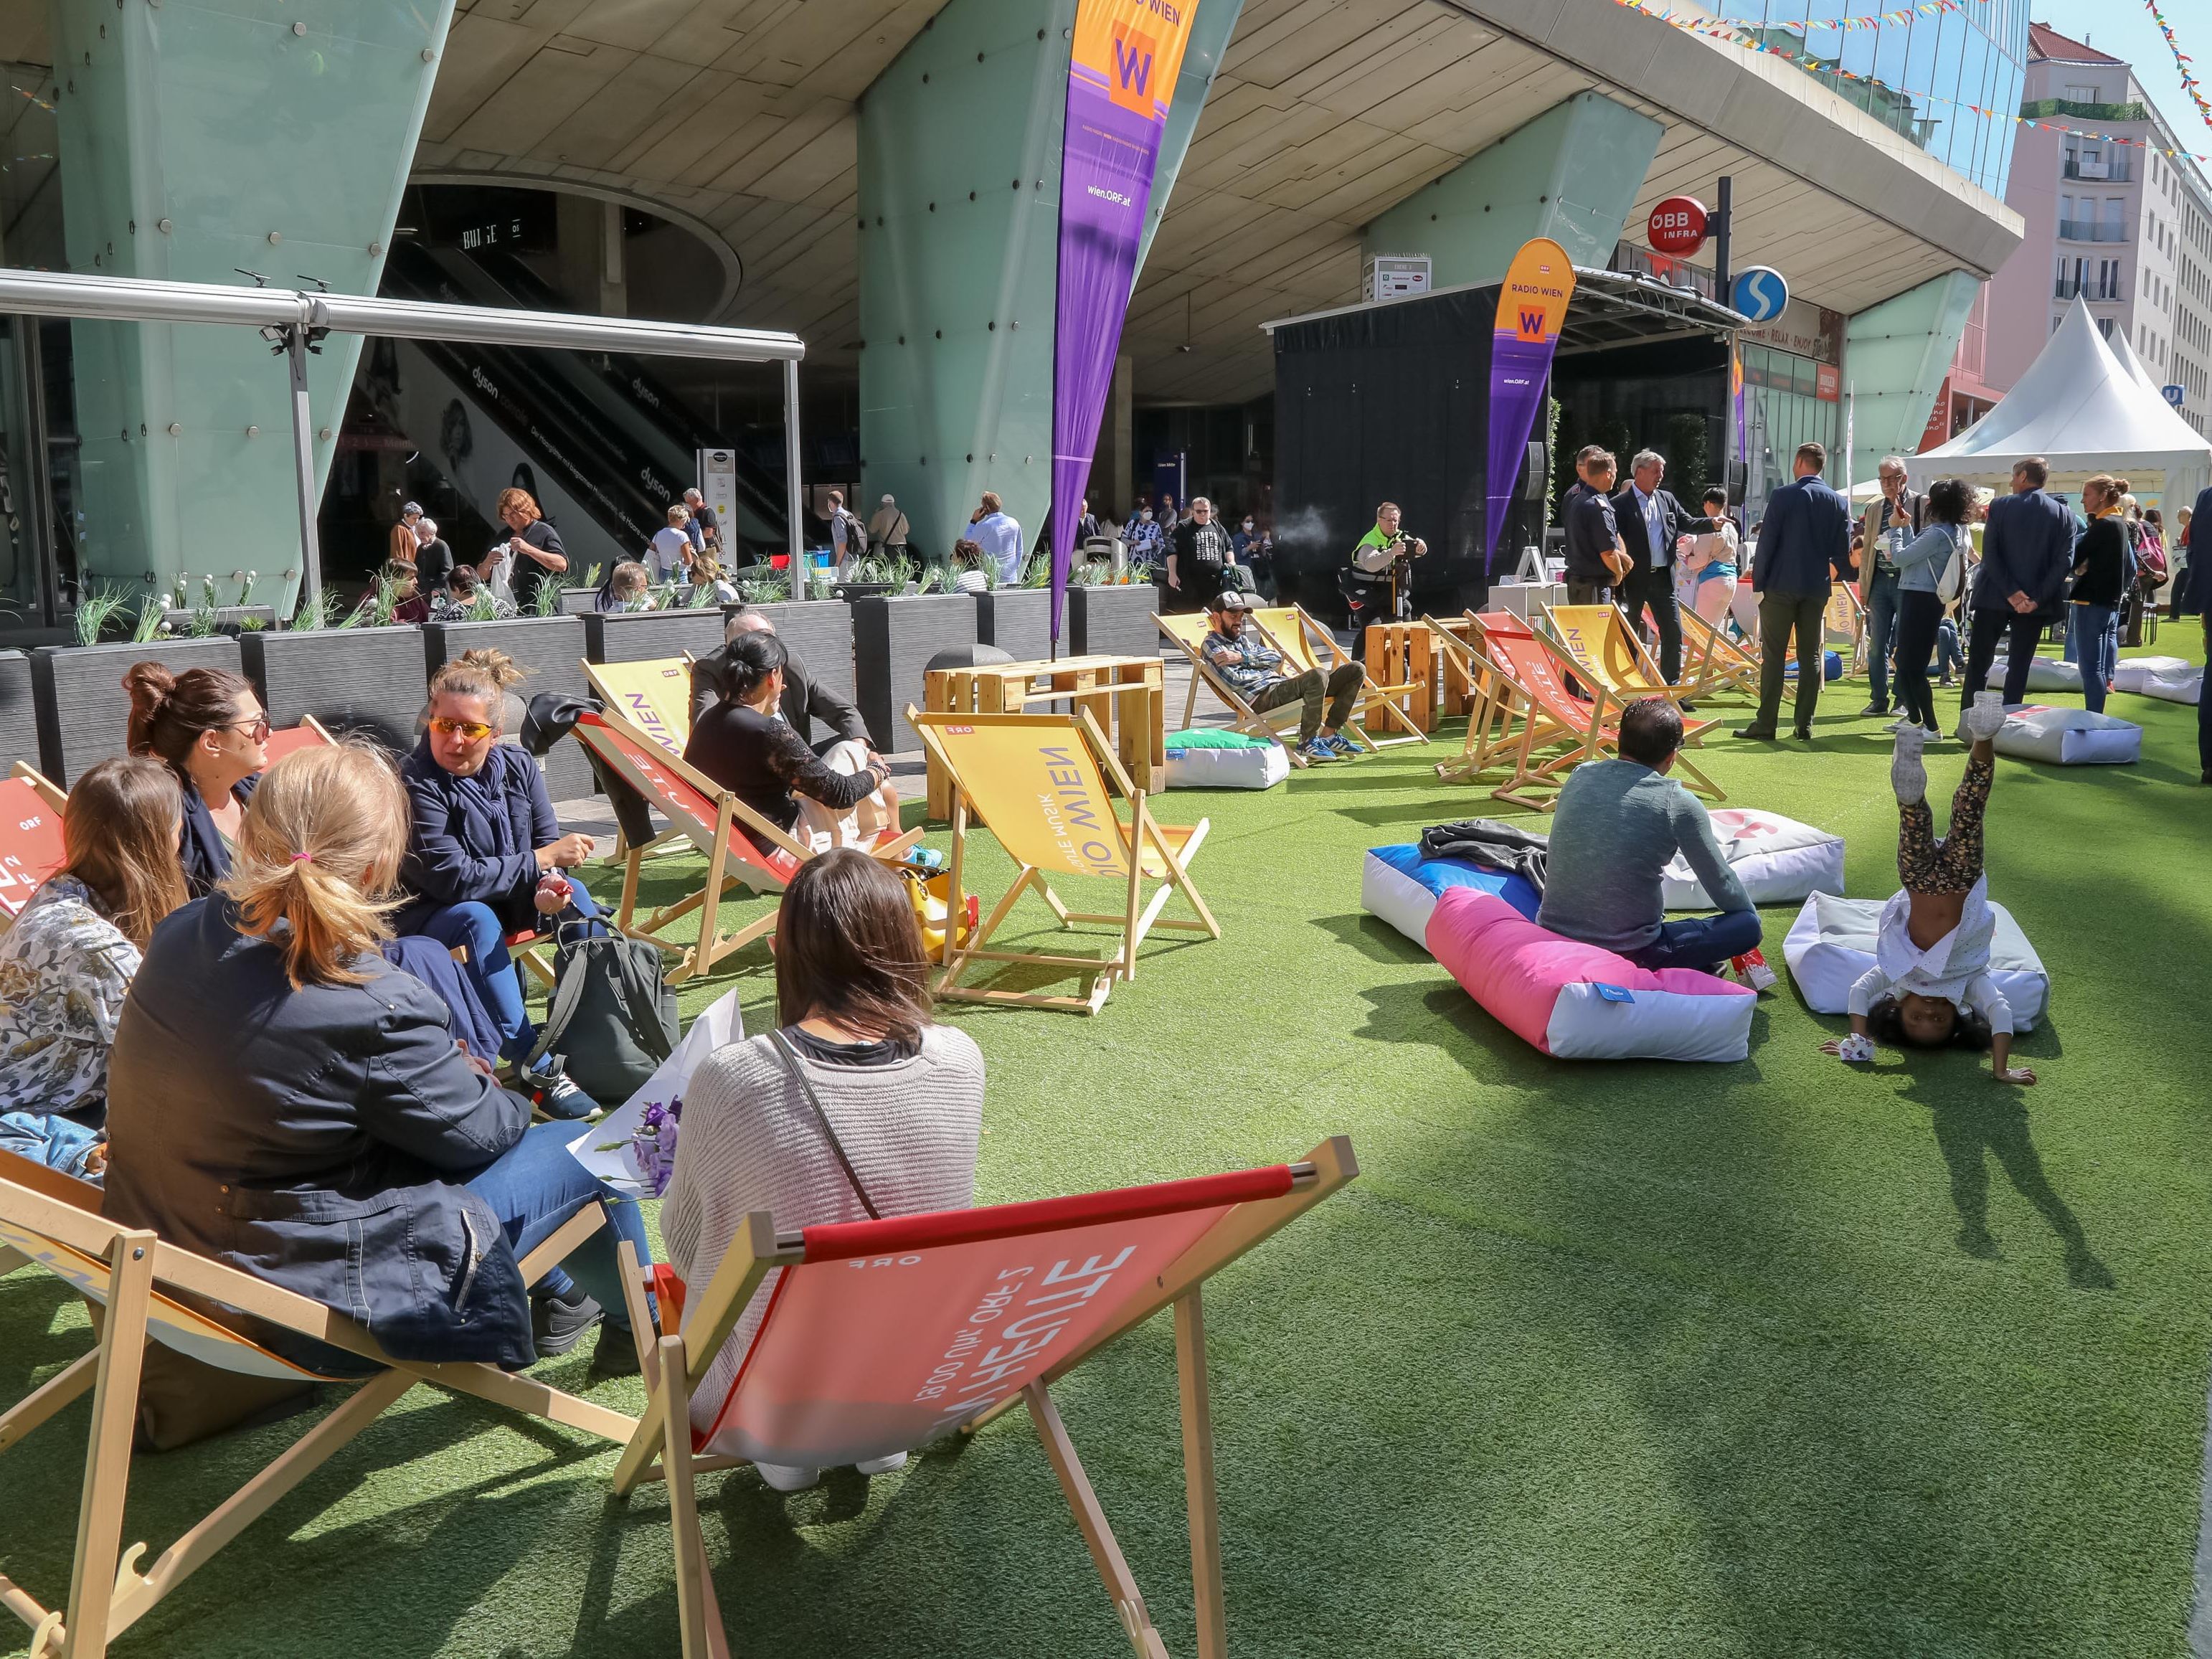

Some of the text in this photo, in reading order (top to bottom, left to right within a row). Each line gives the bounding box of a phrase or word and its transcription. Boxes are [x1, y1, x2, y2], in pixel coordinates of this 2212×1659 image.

[1150, 0, 1180, 27] WIEN
[1115, 38, 1152, 97] W
[1087, 185, 1131, 207] wien.ORF.at
[1652, 212, 1688, 230] ÖBB
[1664, 230, 1698, 239] INFRA
[1511, 284, 1563, 298] RADIO WIEN
[1521, 312, 1544, 334] W
[1771, 329, 1789, 344] RELAX
[1794, 336, 1811, 349] ENJOY
[472, 366, 499, 399] dyson
[632, 378, 660, 409] dyson
[2165, 389, 2179, 402] U
[641, 466, 671, 502] dyson
[625, 516, 641, 536] Haare
[1566, 628, 1594, 673] WIEN
[1531, 661, 1590, 725] HEUTE
[625, 694, 680, 755] WIEN
[19, 816, 42, 831] ORF
[4, 855, 22, 867] 2
